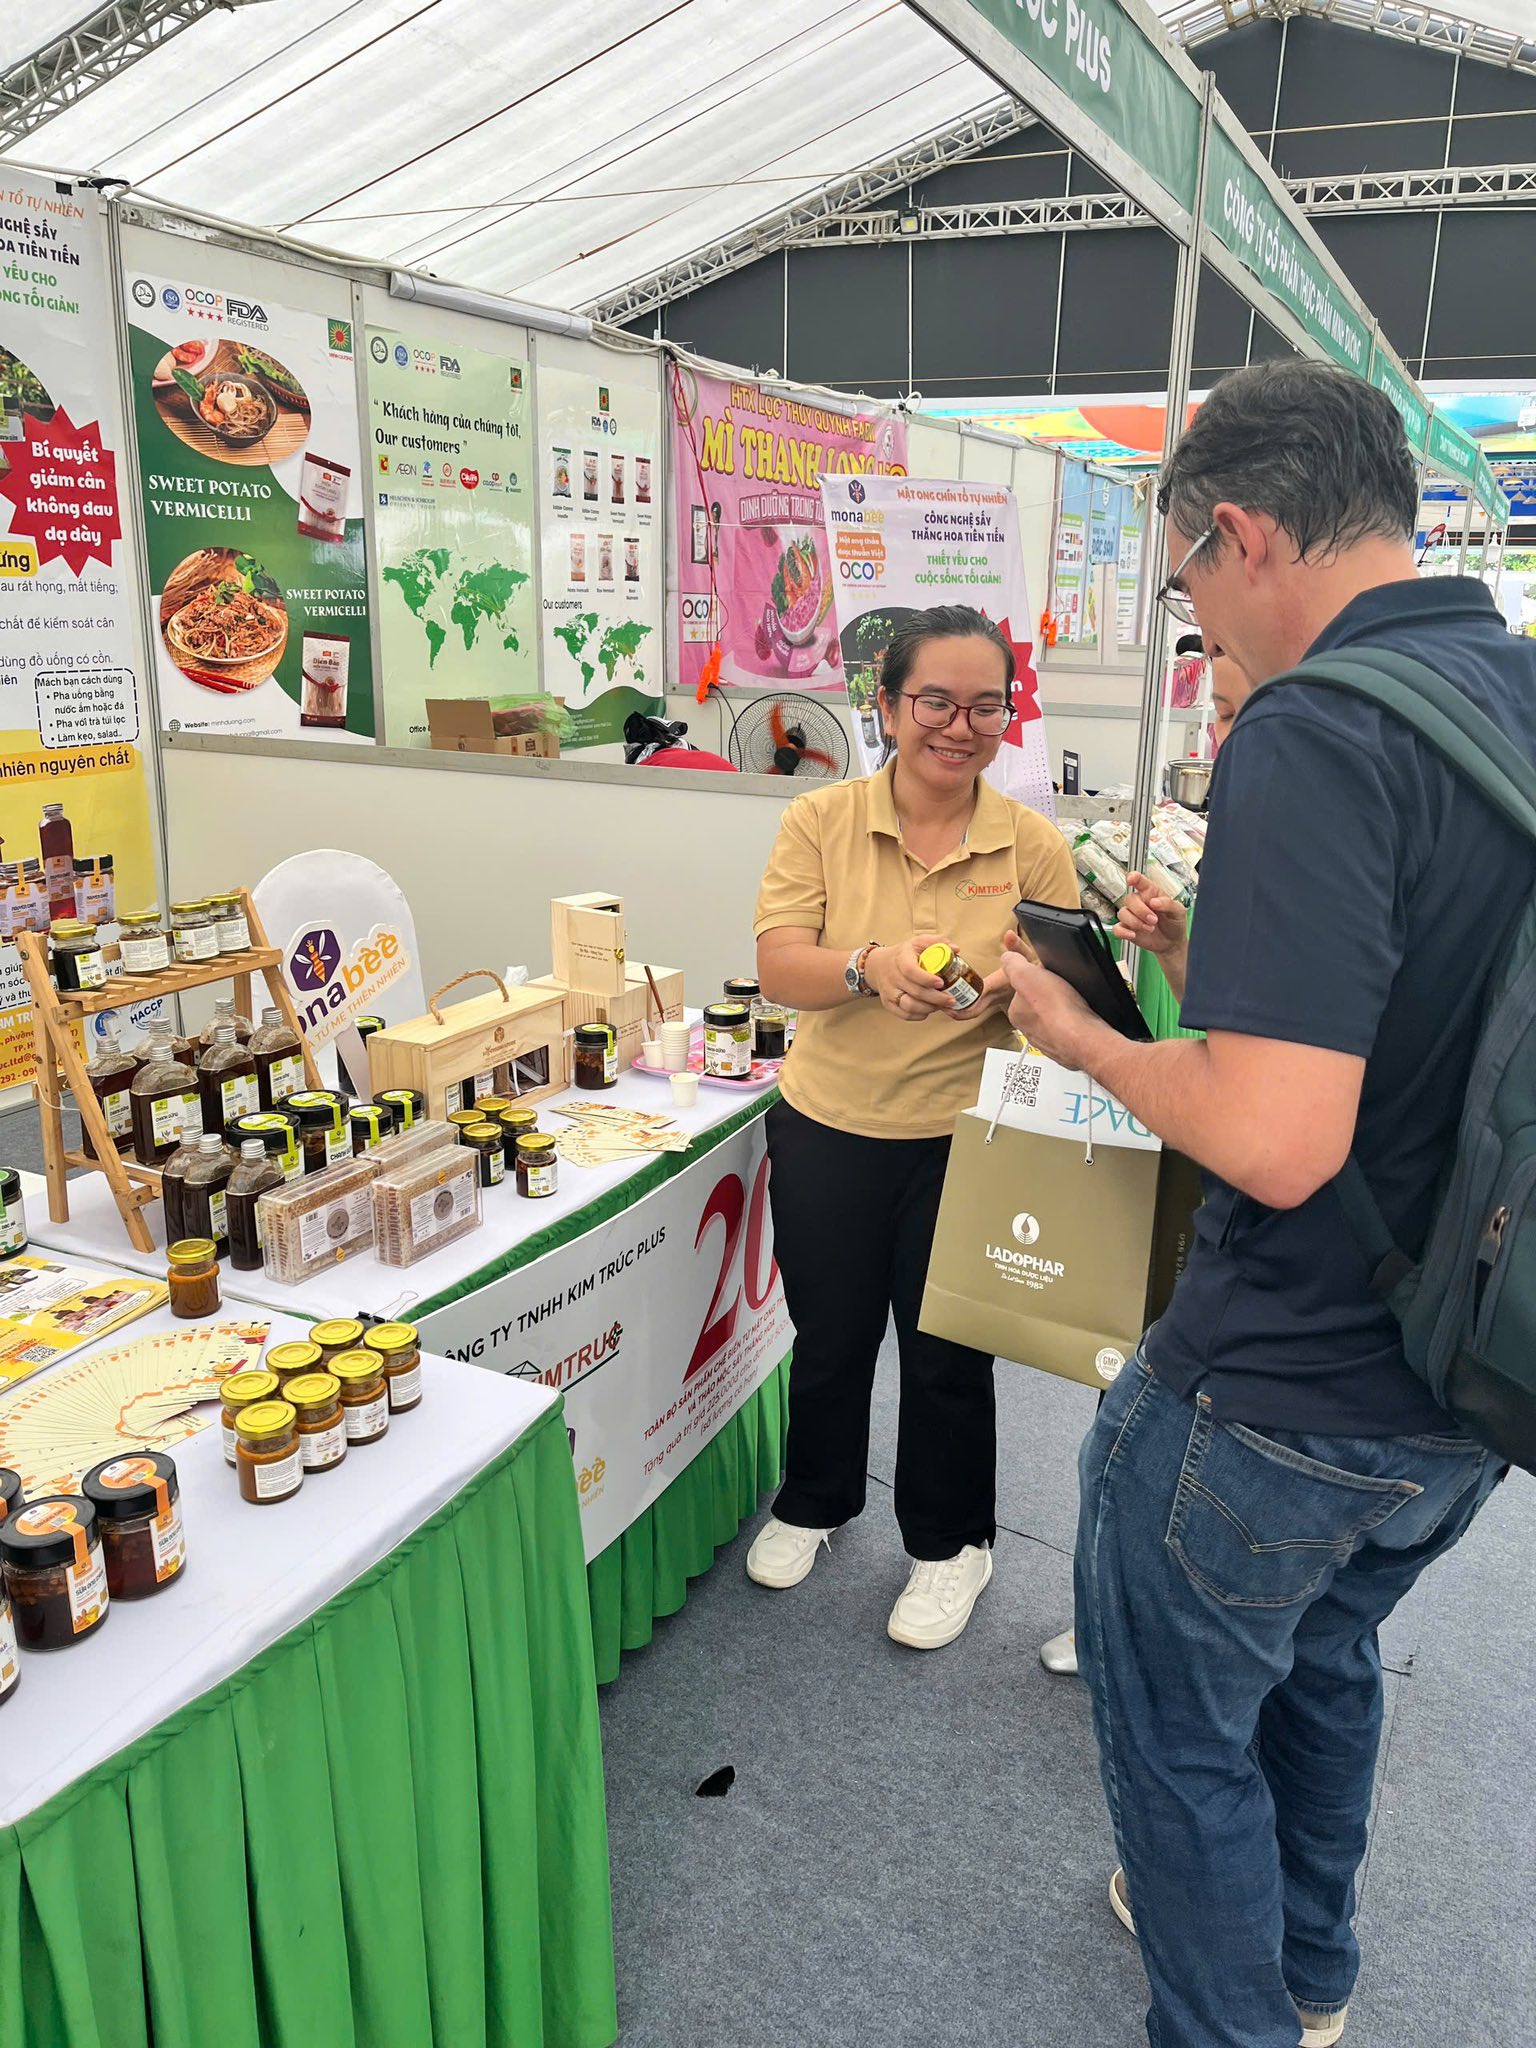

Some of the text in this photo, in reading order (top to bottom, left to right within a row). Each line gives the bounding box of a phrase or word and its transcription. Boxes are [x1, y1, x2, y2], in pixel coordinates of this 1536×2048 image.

[1065, 3, 1112, 93] PLUS
[27, 196, 42, 212] TỰ
[34, 219, 57, 240] SẤY
[1224, 177, 1254, 244] CÔNG
[1255, 212, 1266, 258] TY
[1265, 218, 1280, 272] CỔ
[18, 240, 80, 266] TIÊN TIẾN
[3, 260, 57, 287] YẾU CHO
[23, 287, 80, 314] TỐI GIẢN!
[185, 288, 223, 307] OCOP
[226, 299, 269, 323] FDA
[227, 316, 269, 332] REGISTERED
[413, 349, 436, 362] OCOP
[440, 356, 461, 373] FDA
[731, 384, 755, 412] HTX
[383, 401, 419, 422] Khách
[423, 408, 450, 431] hàng
[453, 414, 472, 430] của
[474, 417, 503, 439] chúng
[376, 428, 460, 454] Our customers
[701, 408, 735, 475] MÌ
[741, 425, 820, 489] THANH
[32, 440, 98, 465] Bí quyết
[30, 468, 105, 489] giảm cân
[149, 474, 272, 500] SWEET POTATO
[897, 486, 915, 503] MẬT
[917, 490, 934, 501] ONG
[936, 488, 956, 502] CHÍN
[982, 491, 1008, 505] NHIÊN
[26, 496, 80, 519] không
[152, 501, 252, 521] VERMICELLI
[740, 497, 759, 522] DINH
[791, 496, 815, 520] TRONG
[925, 510, 991, 526] CÔNG NGHỆ SẤY
[45, 524, 101, 546] dạ dày
[912, 526, 1005, 543] THĂNG HOA TIÊN TIẾN
[927, 549, 988, 566] THIẾT YẾU CHO
[840, 561, 885, 581] OCOP
[915, 567, 1002, 587] CUỘC SỐNG TỐI GIẢN!
[18, 578, 88, 595] rát họng, mất
[287, 589, 365, 600] SWEET POTATO
[304, 606, 366, 617] VERMICELLI
[543, 599, 582, 610] Our customers
[27, 617, 115, 630] để kiểm soát cân
[29, 652, 44, 667] đồ
[46, 651, 74, 668] uống
[77, 657, 90, 665] có
[37, 673, 123, 688] Mách bạn cách dùng
[53, 687, 115, 701] Pha uống bằng
[55, 701, 125, 715] nước hoặc đá
[56, 714, 126, 728] Pha với trà túi lọc
[184, 721, 210, 729] Website:
[57, 730, 96, 743] Làm kẹo,
[40, 746, 129, 775] nguyên chất
[8, 977, 25, 989] sóc
[6, 992, 17, 1002] và
[130, 998, 164, 1024] HACCP
[985, 1243, 1065, 1277] LADOPHAR
[994, 1262, 1008, 1271] TINH
[1008, 1266, 1020, 1275] HOA
[1021, 1270, 1039, 1280] DƯỢC
[490, 1226, 666, 1348] TY TNHH KIM TRÚC PLUS
[1026, 1280, 1044, 1289] 1982
[688, 1401, 697, 1415] VÀ
[698, 1381, 716, 1405] THẢO
[716, 1368, 731, 1388] MỘC
[732, 1352, 744, 1375] SẤY
[763, 1317, 776, 1338] HOA
[643, 1339, 742, 1441] TOÀN BỘ SẢN PHẨM BIẾN
[643, 1448, 665, 1477] Tặng
[666, 1431, 682, 1454] quà
[683, 1421, 692, 1439] trị
[693, 1407, 706, 1430] giá
[739, 1358, 753, 1377] cho
[700, 1384, 742, 1437] (số lượng có
